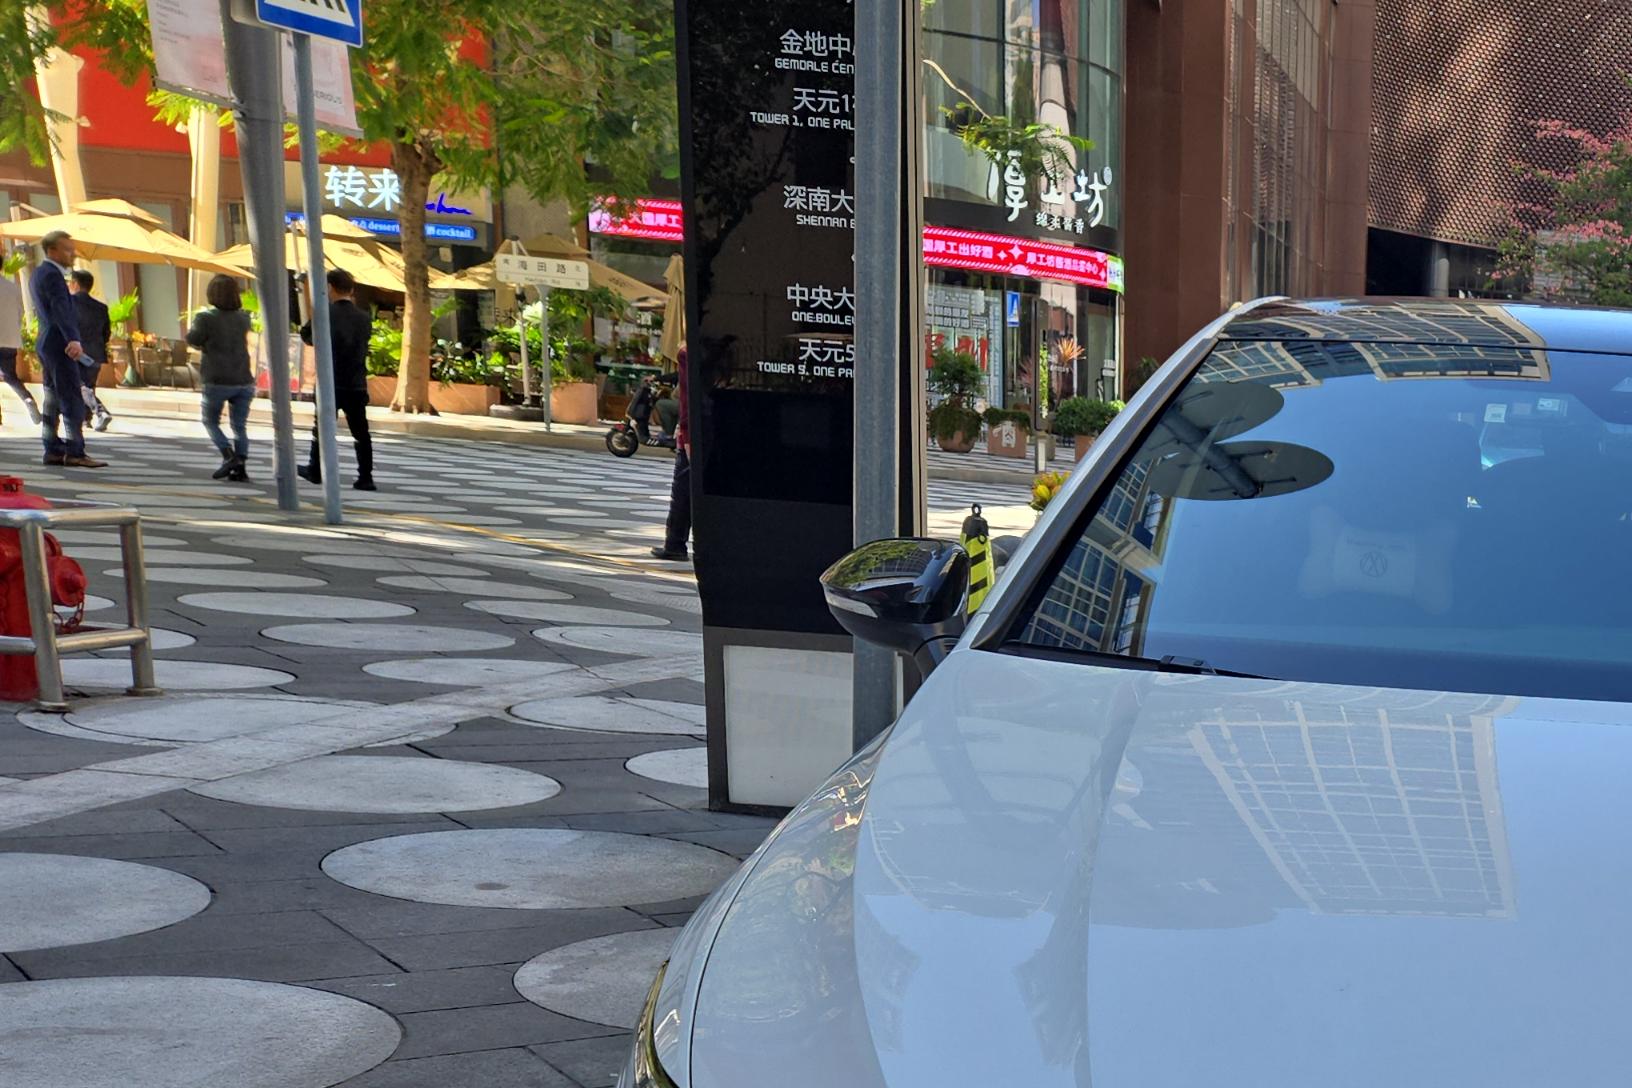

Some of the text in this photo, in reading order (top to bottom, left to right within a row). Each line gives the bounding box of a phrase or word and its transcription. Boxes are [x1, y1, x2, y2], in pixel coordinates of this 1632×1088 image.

[779, 28, 855, 59] 金地中
[775, 58, 828, 72] GEMDALE
[793, 87, 855, 114] 天元1
[749, 111, 790, 125] TOWER
[807, 116, 831, 129] ONE
[783, 185, 854, 214] 深南大
[796, 214, 847, 228] SHENNAN
[786, 282, 855, 310] 中央大
[791, 311, 814, 322] ONE
[757, 361, 795, 374] TOWER
[813, 366, 836, 377] ONE
